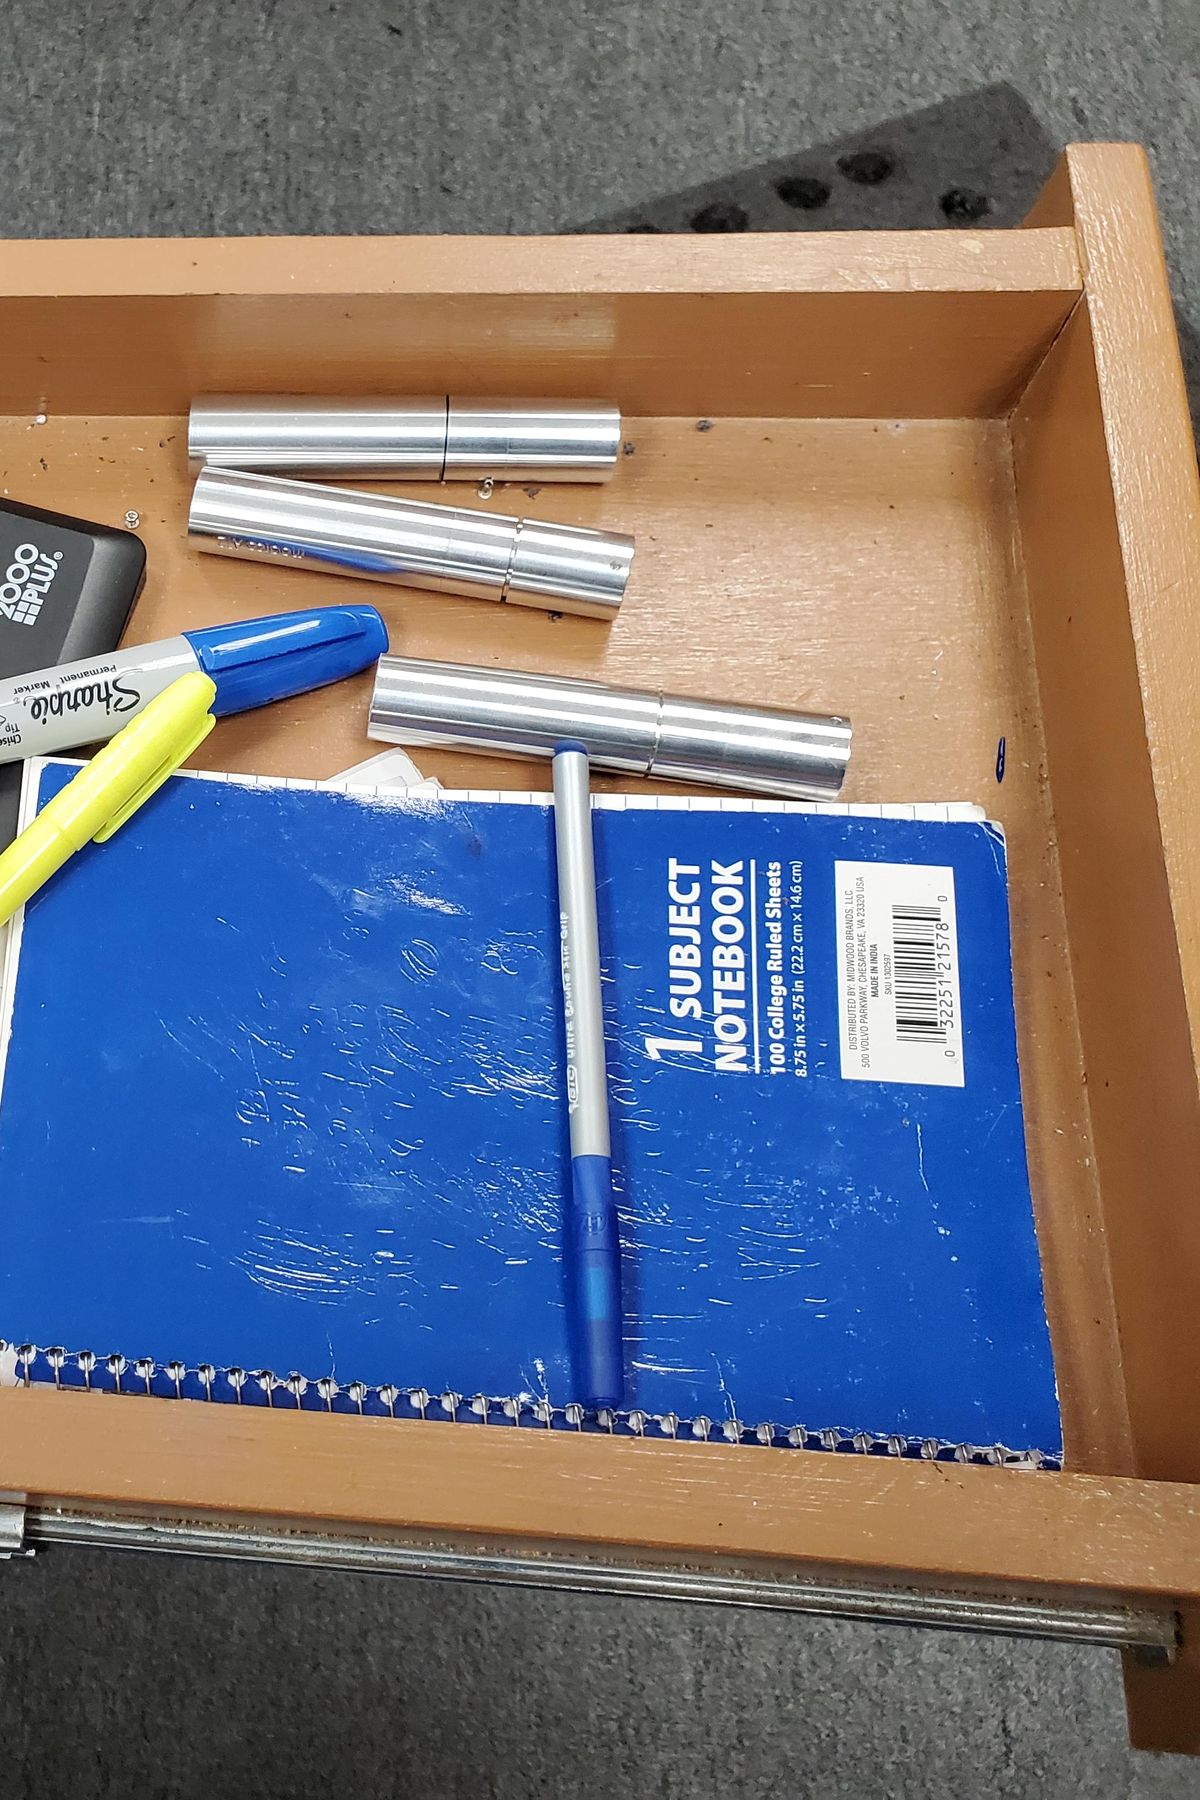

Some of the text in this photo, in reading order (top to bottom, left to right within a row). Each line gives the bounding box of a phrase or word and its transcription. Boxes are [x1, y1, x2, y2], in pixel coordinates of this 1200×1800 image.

[13, 665, 118, 695] Permanent Marker
[24, 669, 141, 725] Sharpie
[5, 723, 20, 734] Tip
[788, 860, 803, 884] cm)
[790, 885, 802, 909] 14.6
[793, 924, 804, 943] cm
[644, 858, 702, 1061] 1 SUBJECT
[711, 860, 748, 1073] NOTEBOOK
[764, 861, 788, 1075] 100 College Ruled Sheets
[790, 944, 805, 975] (22.2
[844, 890, 858, 1051] DISTRIBUTED BY: MIDWOOD BRANDS, LLC
[855, 876, 871, 1069] 500 VOLVO PARKWAY, CHESAPEAKE, VA 23320 USA
[869, 943, 879, 998] MADE IN INDIA
[883, 953, 893, 995] SKU 1302597
[791, 979, 805, 992] in
[935, 895, 956, 1058] 0 32251 21578 0
[791, 994, 805, 1021] 5.75
[791, 1034, 806, 1047] in
[793, 1048, 808, 1078] 8.75
